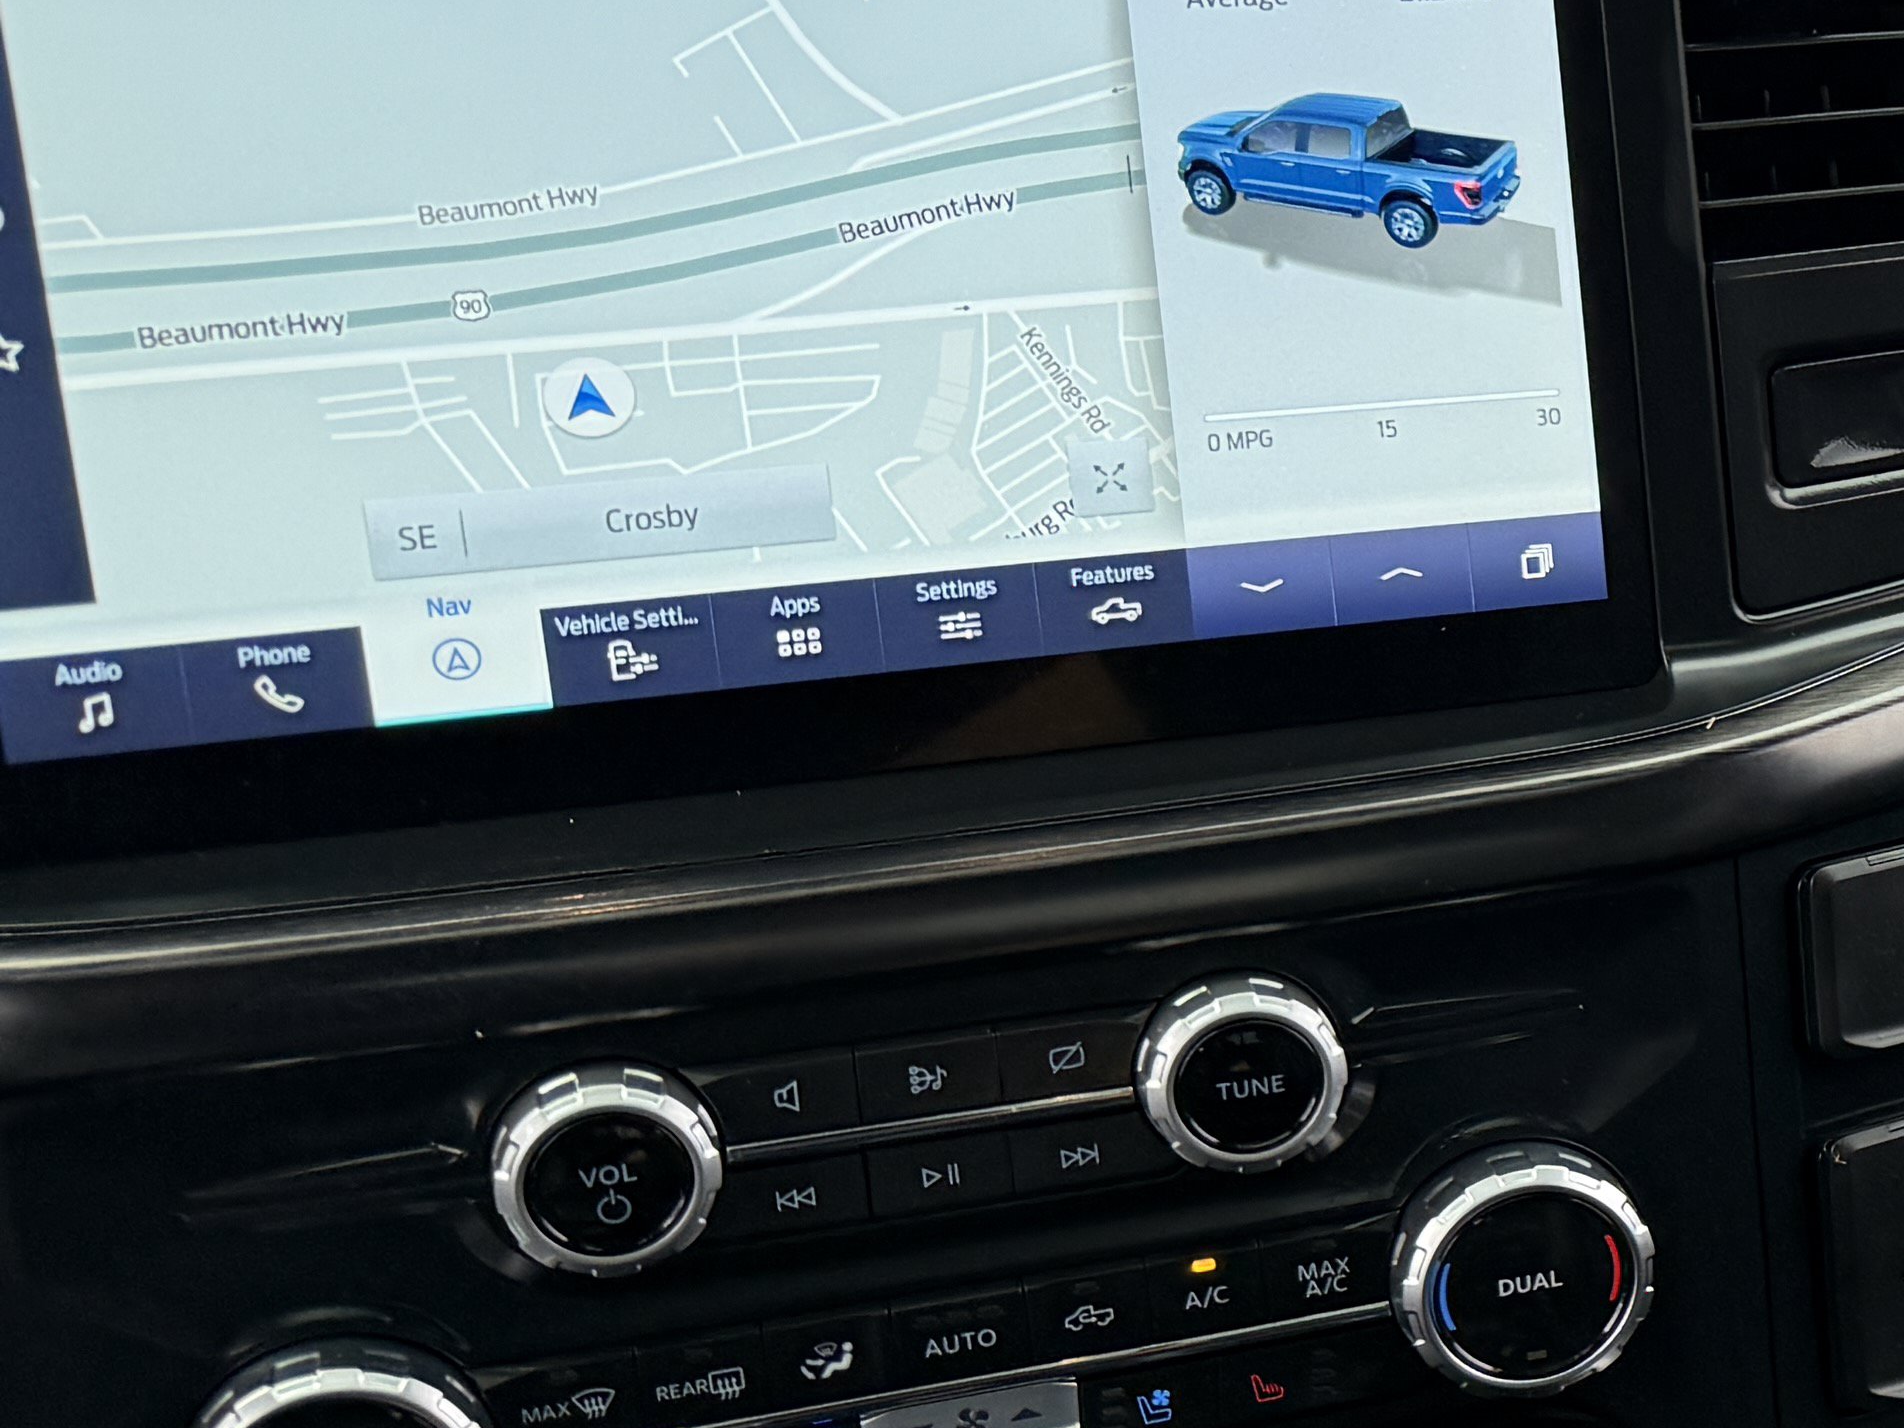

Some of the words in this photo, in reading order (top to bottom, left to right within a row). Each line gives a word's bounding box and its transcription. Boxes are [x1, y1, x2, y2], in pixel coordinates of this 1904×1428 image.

[417, 192, 544, 226] Beaumont
[546, 186, 598, 209] Hwy
[838, 198, 961, 243] Beaumont
[964, 191, 1015, 214] Hwy
[459, 298, 482, 314] 90
[137, 316, 281, 349] Beaumont
[286, 313, 344, 336] Hwy
[1020, 326, 1088, 410] Kennings
[1081, 404, 1111, 433] Rd
[1376, 419, 1398, 439] 15
[1536, 407, 1562, 426] 30
[1207, 433, 1221, 452] 0
[1227, 429, 1273, 451] MPG
[605, 503, 699, 533] Crosby
[398, 524, 438, 551] SE
[1071, 564, 1155, 588] Features
[916, 578, 998, 603] Settings
[426, 596, 472, 618] Nav
[770, 595, 821, 619] Apps
[554, 611, 630, 637] Vehicle
[237, 644, 312, 669] Phone
[55, 660, 123, 687] Audio
[1215, 1073, 1286, 1101] TUNE
[578, 1162, 638, 1187] VOL
[1298, 1256, 1350, 1281] MAX
[1306, 1274, 1348, 1298] A/C
[1497, 1270, 1564, 1299] DUAL
[1185, 1285, 1230, 1311] A/C
[924, 1328, 997, 1359] AUTO
[656, 1378, 709, 1402] REAR
[521, 1401, 572, 1426] MAX
